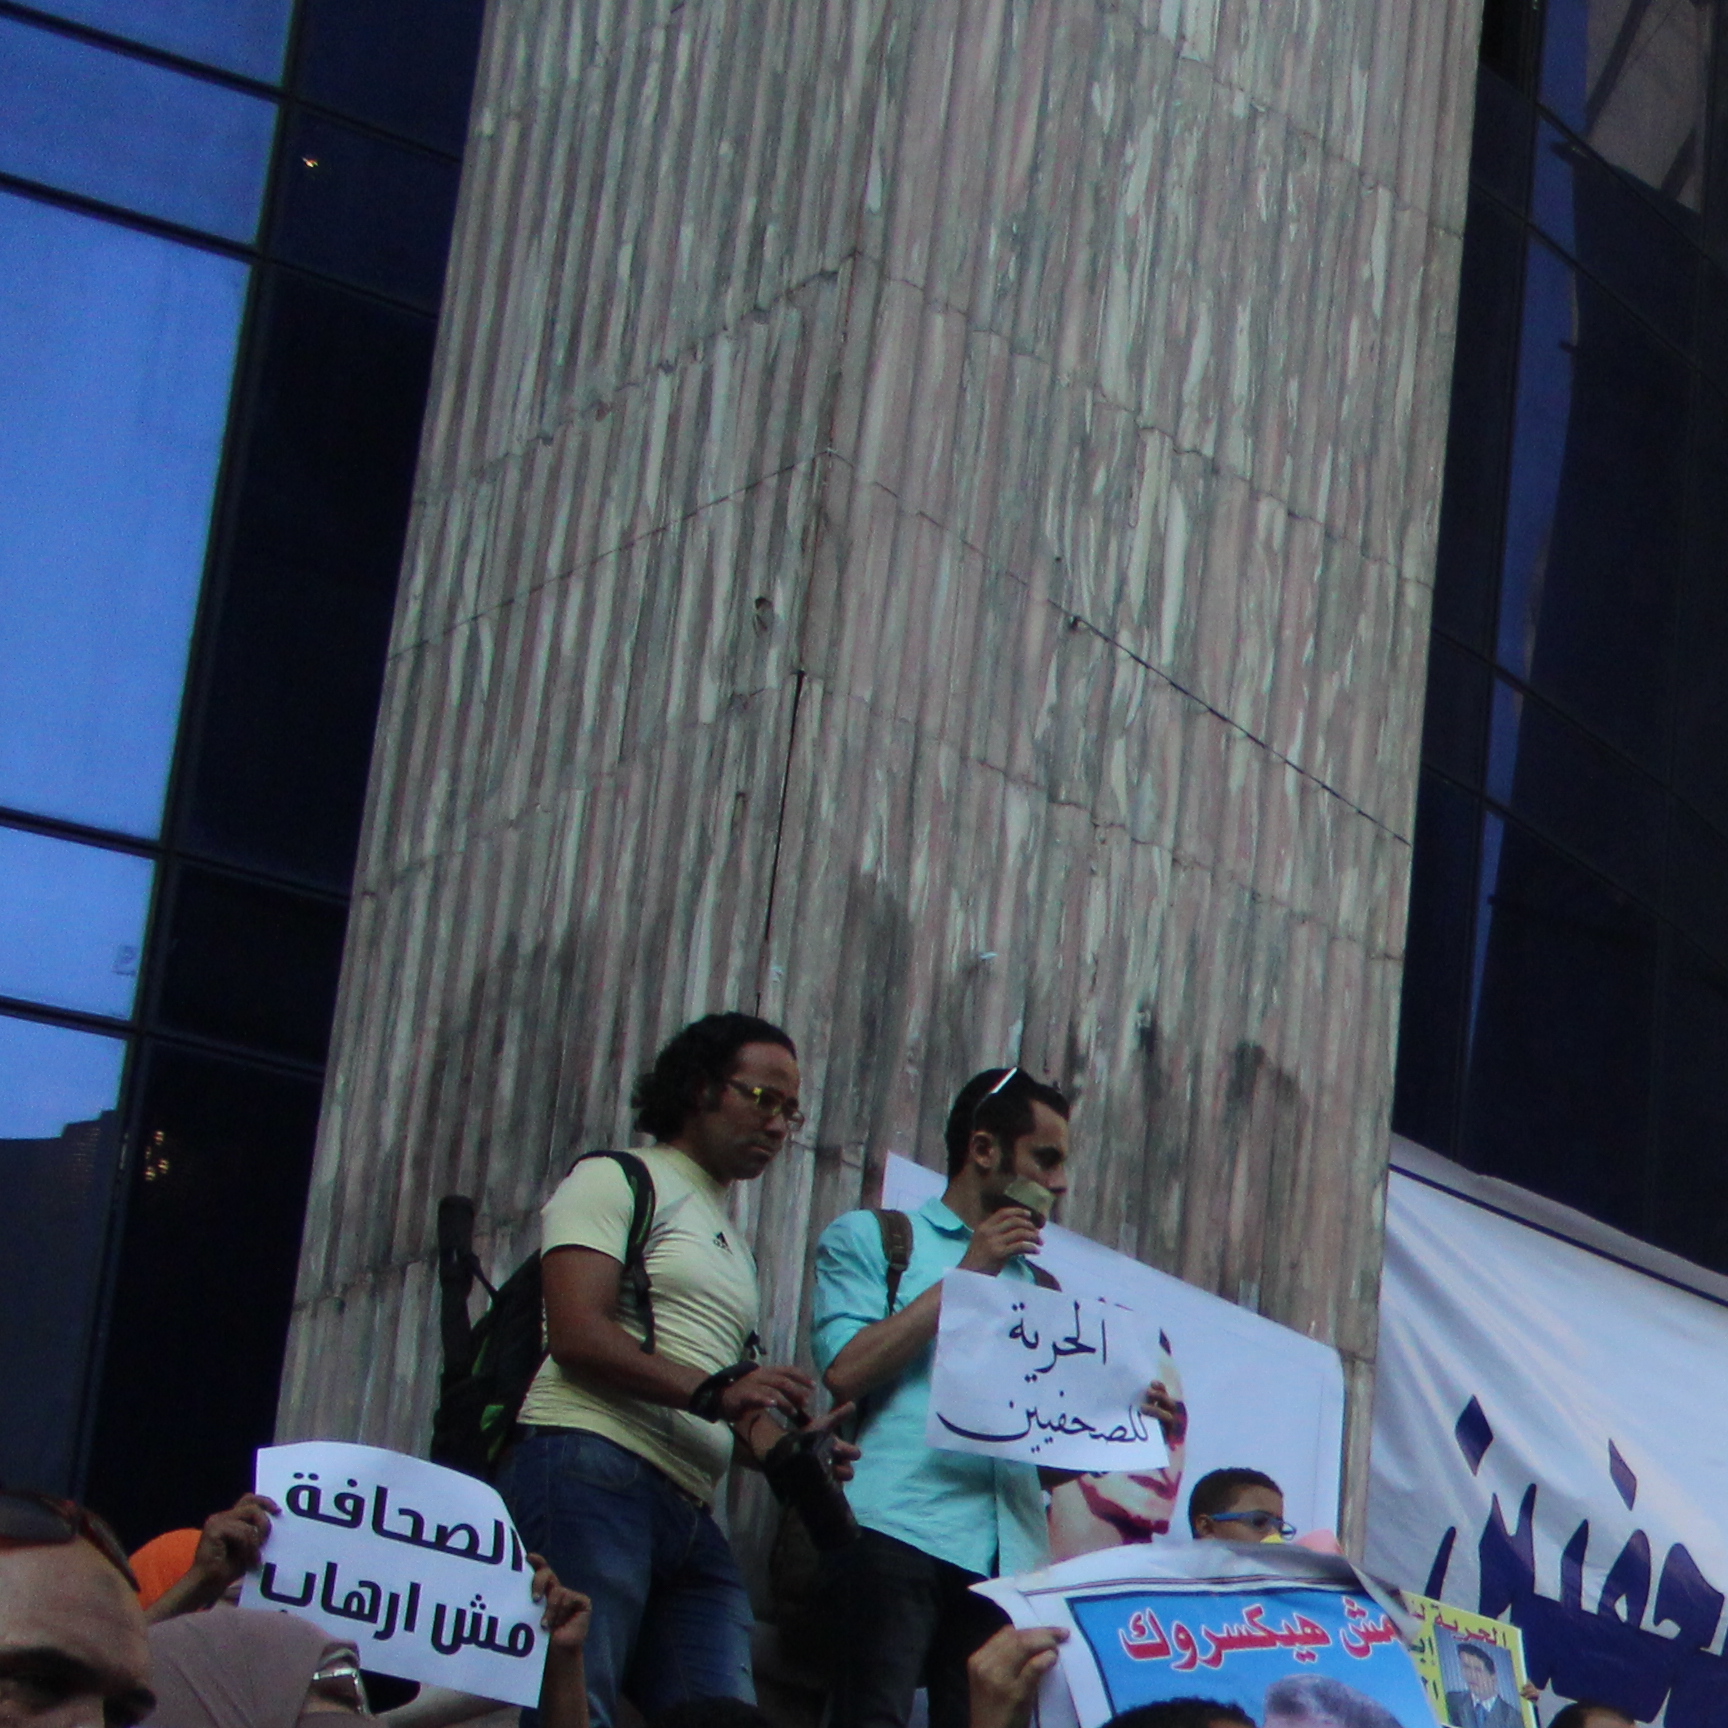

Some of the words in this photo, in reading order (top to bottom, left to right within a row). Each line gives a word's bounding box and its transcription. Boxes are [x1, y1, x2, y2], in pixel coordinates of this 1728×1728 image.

[1008, 1300, 1107, 1383] الحرية
[936, 1390, 1149, 1455] للصحفيين
[285, 1472, 523, 1573] الصحافة
[259, 1561, 422, 1641] ارهاب
[431, 1593, 536, 1656] مش
[1118, 1602, 1332, 1672] هيكسروك
